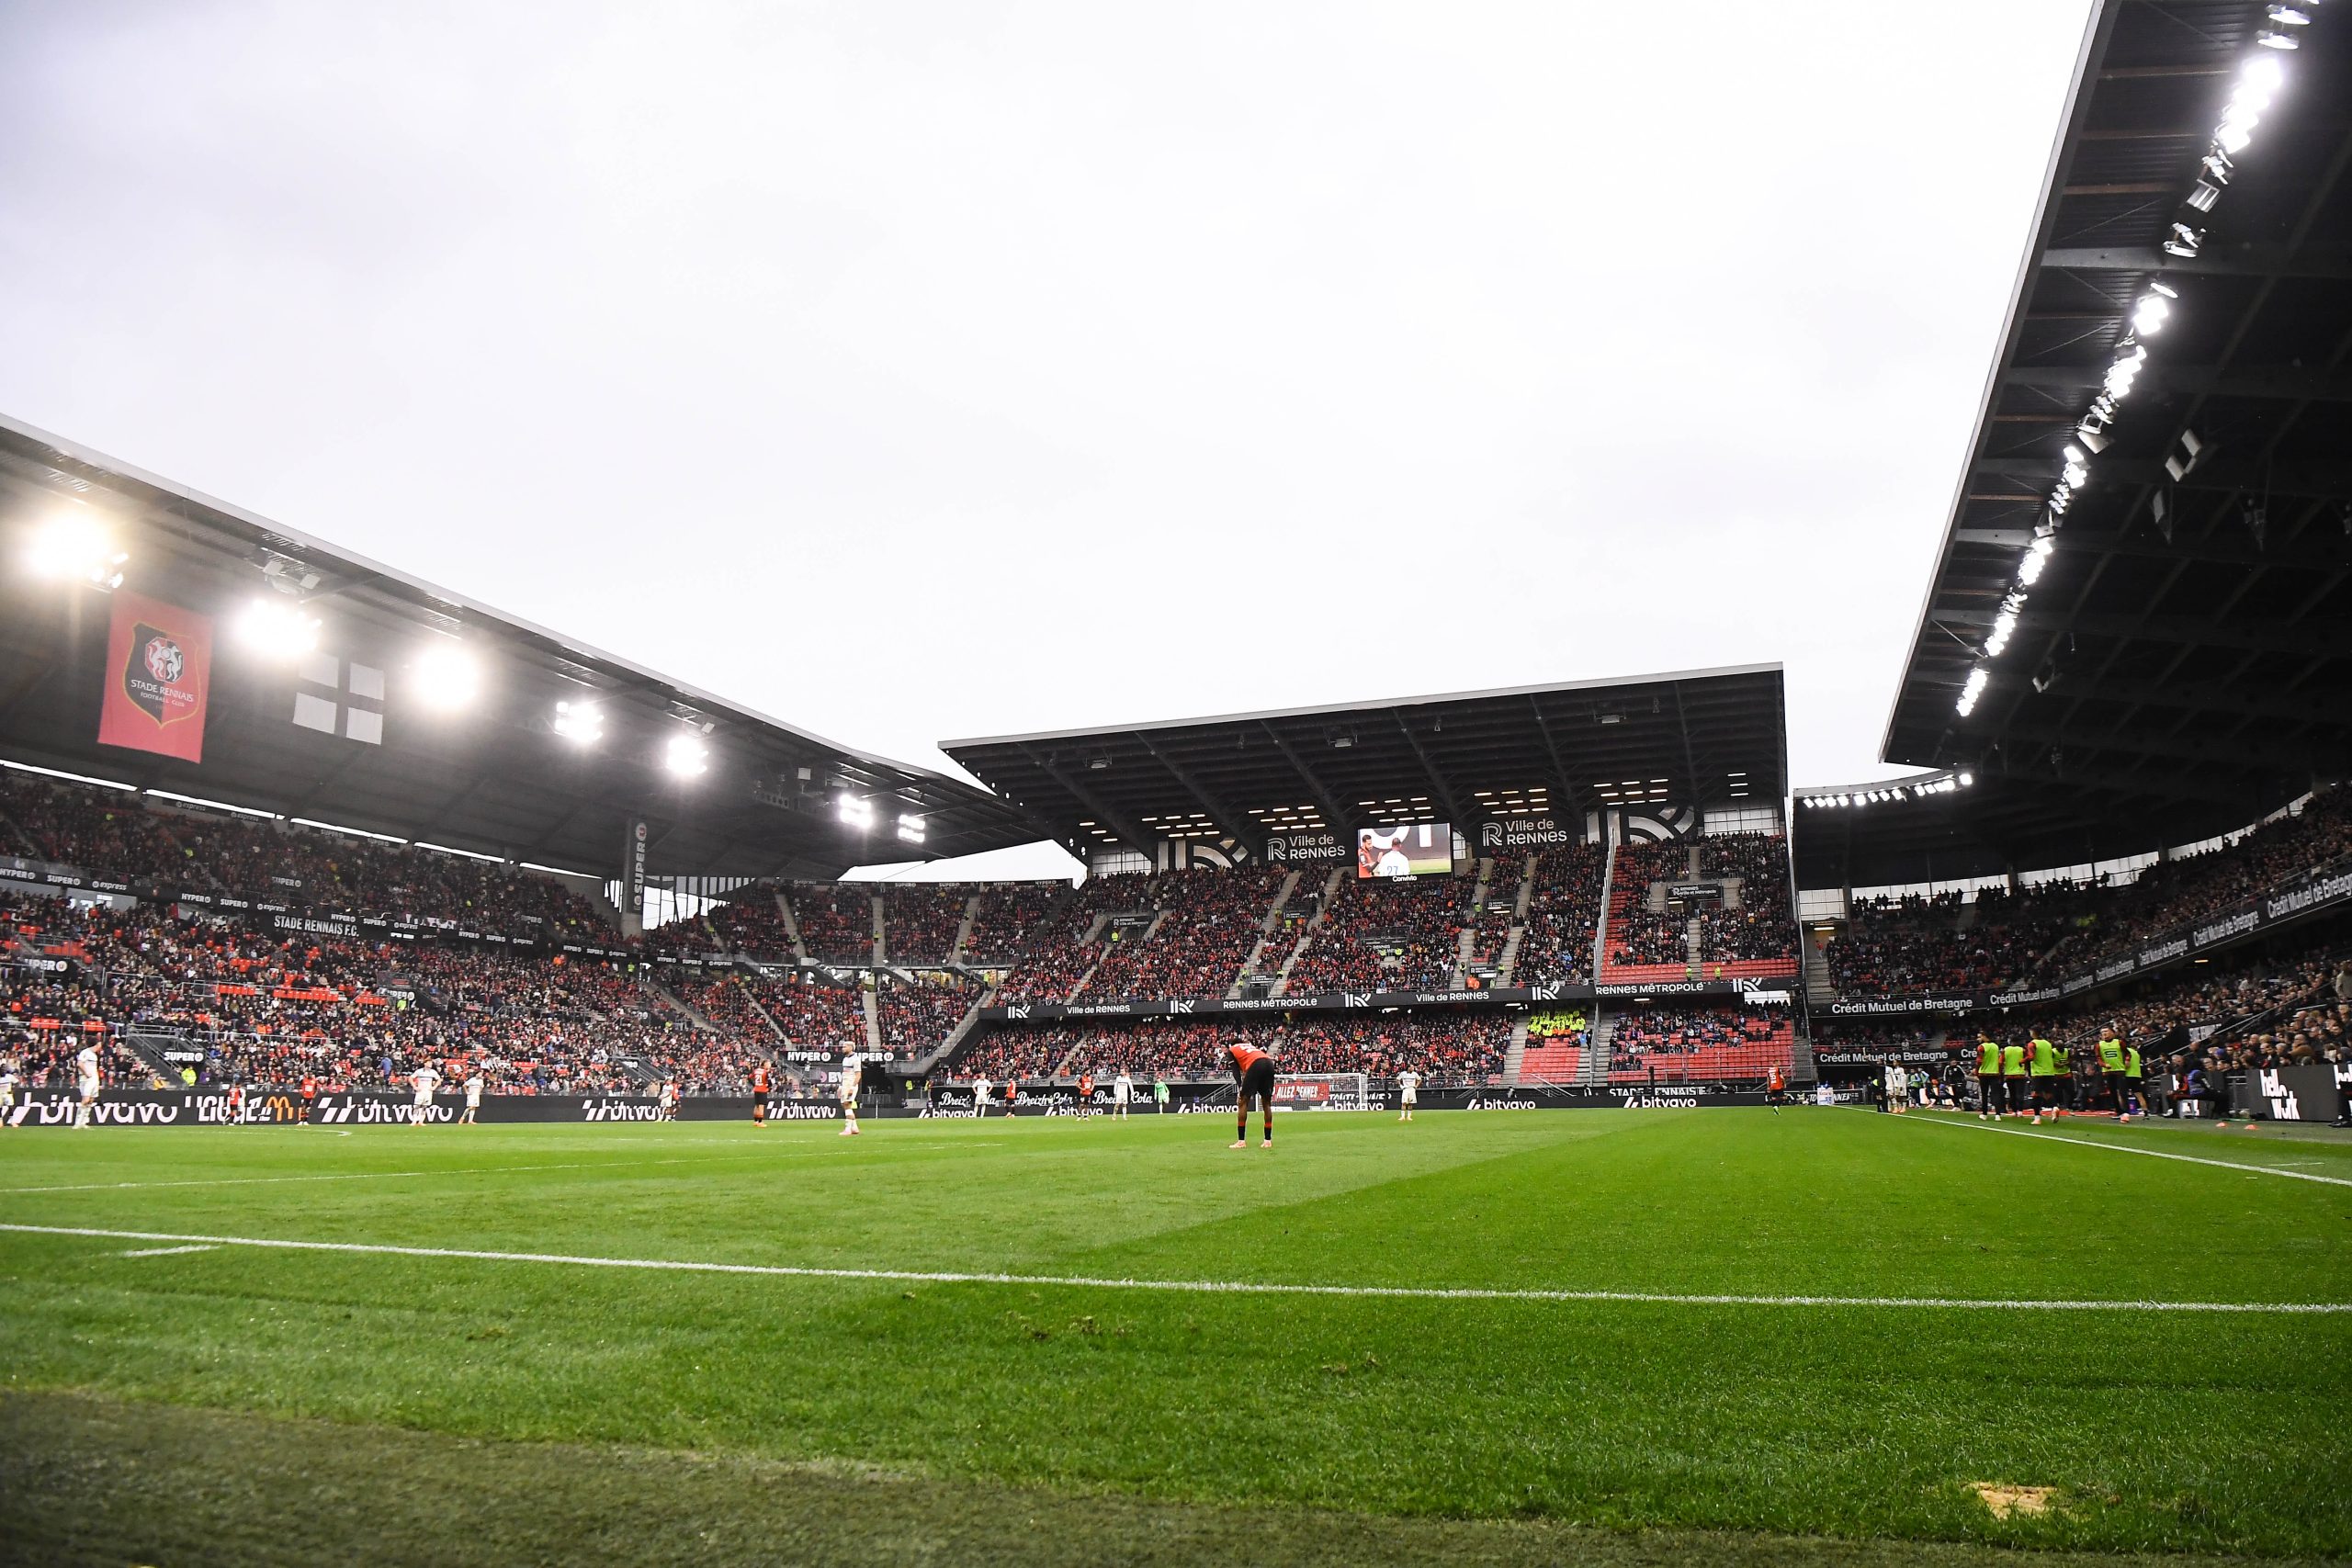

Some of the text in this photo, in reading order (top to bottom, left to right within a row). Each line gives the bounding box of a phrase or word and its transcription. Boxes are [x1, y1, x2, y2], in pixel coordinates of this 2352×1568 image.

[130, 680, 194, 702] STADE RENNAIS
[1505, 819, 1534, 832] Ville
[1537, 818, 1555, 829] de
[1289, 835, 1316, 846] Ville
[1317, 834, 1334, 845] de
[1507, 830, 1567, 845] RENNES
[1290, 845, 1345, 860] RENNES
[0, 868, 28, 879] HYPER
[634, 842, 646, 894] SUPER
[47, 874, 74, 885] SUPER
[100, 882, 127, 890] express
[182, 893, 205, 902] HYPER
[2288, 886, 2313, 910] Mutuel
[2312, 883, 2324, 902] de
[220, 898, 243, 908] SUPER
[264, 904, 286, 912] express
[331, 913, 350, 921] HYPER
[363, 918, 381, 926] SUPER
[274, 915, 359, 937] STADE RENNAIS F.C.
[458, 931, 475, 939] HYPER
[1595, 985, 1637, 995] RENNES
[1415, 990, 1489, 1002] Ville de RENNES
[1990, 993, 2017, 1005] Crédit
[2017, 990, 2040, 1002] Mutuel
[1067, 1004, 1130, 1014] Ville de RENNES
[1223, 999, 1260, 1009] RENNES
[1832, 998, 1973, 1014] Crédit Mutuel de Bretagne
[164, 1052, 195, 1061] SUPER
[787, 1052, 821, 1061] HYPER
[856, 1052, 883, 1061] UPER
[1819, 1053, 1850, 1063] Crédit
[1888, 1052, 1901, 1061] de
[1903, 1050, 1948, 1062] Bretagne
[1132, 1090, 1153, 1104] Cola
[1276, 1085, 1295, 1099] ALLEZ
[1193, 1102, 1239, 1113] bitvavo
[1335, 1100, 1384, 1111] bitvavo
[1484, 1098, 1536, 1110] bitvavo
[1642, 1096, 1697, 1108] bitvavo
[347, 1097, 453, 1122] bitvavo
[781, 1100, 836, 1119] bitvavo
[933, 1109, 976, 1118] bitvavo
